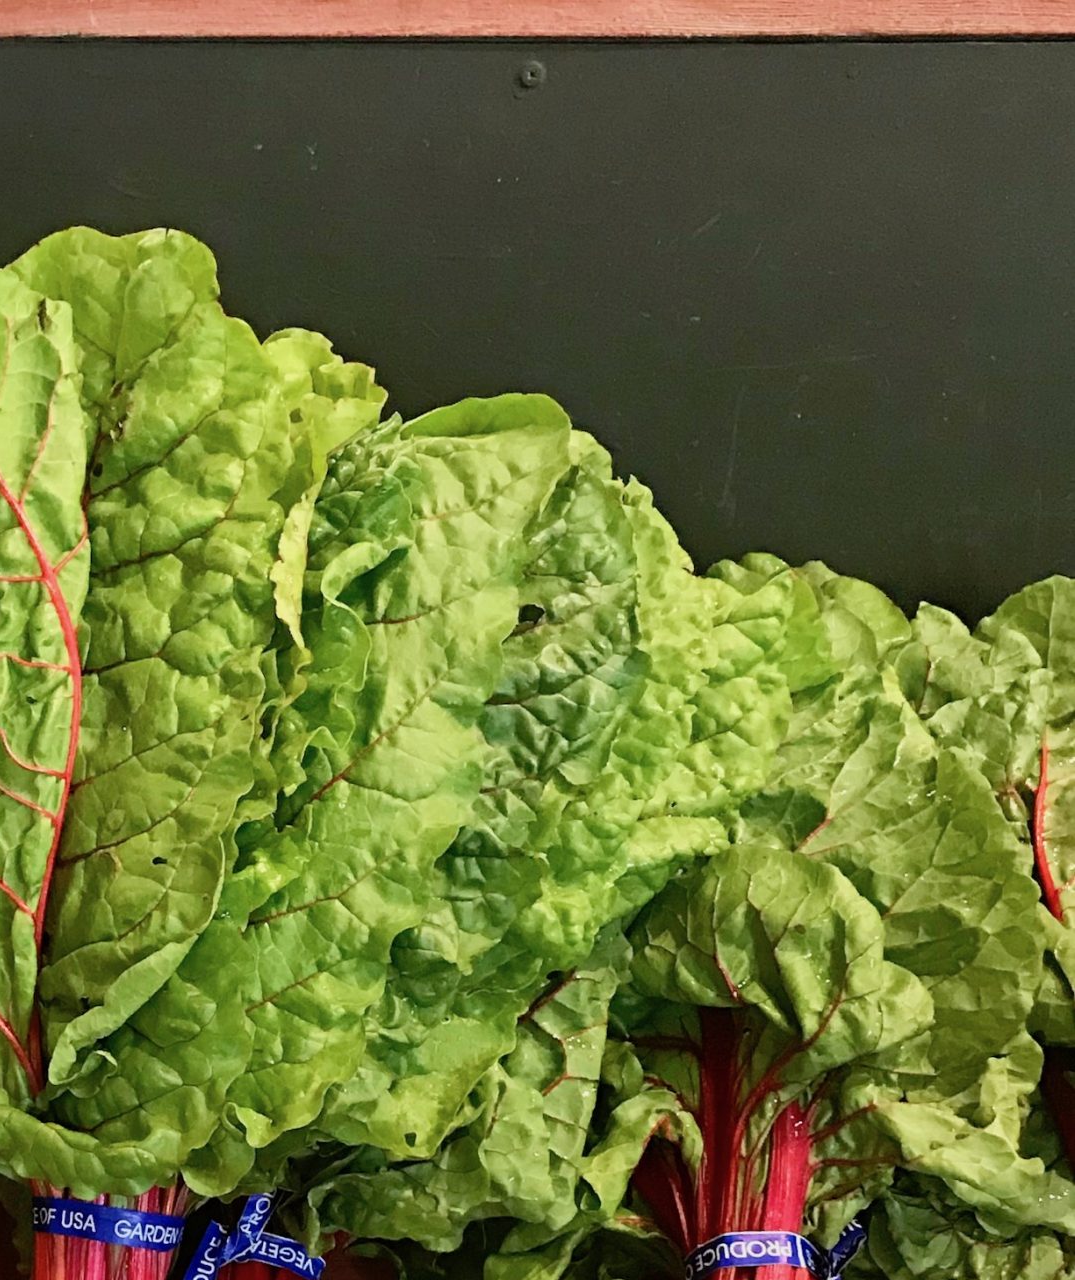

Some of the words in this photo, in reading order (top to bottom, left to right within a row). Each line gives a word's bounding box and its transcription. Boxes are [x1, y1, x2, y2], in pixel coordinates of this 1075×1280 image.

[61, 1210, 97, 1233] USA
[114, 1219, 177, 1245] GARDEN
[695, 1240, 792, 1274] PRODUCE
